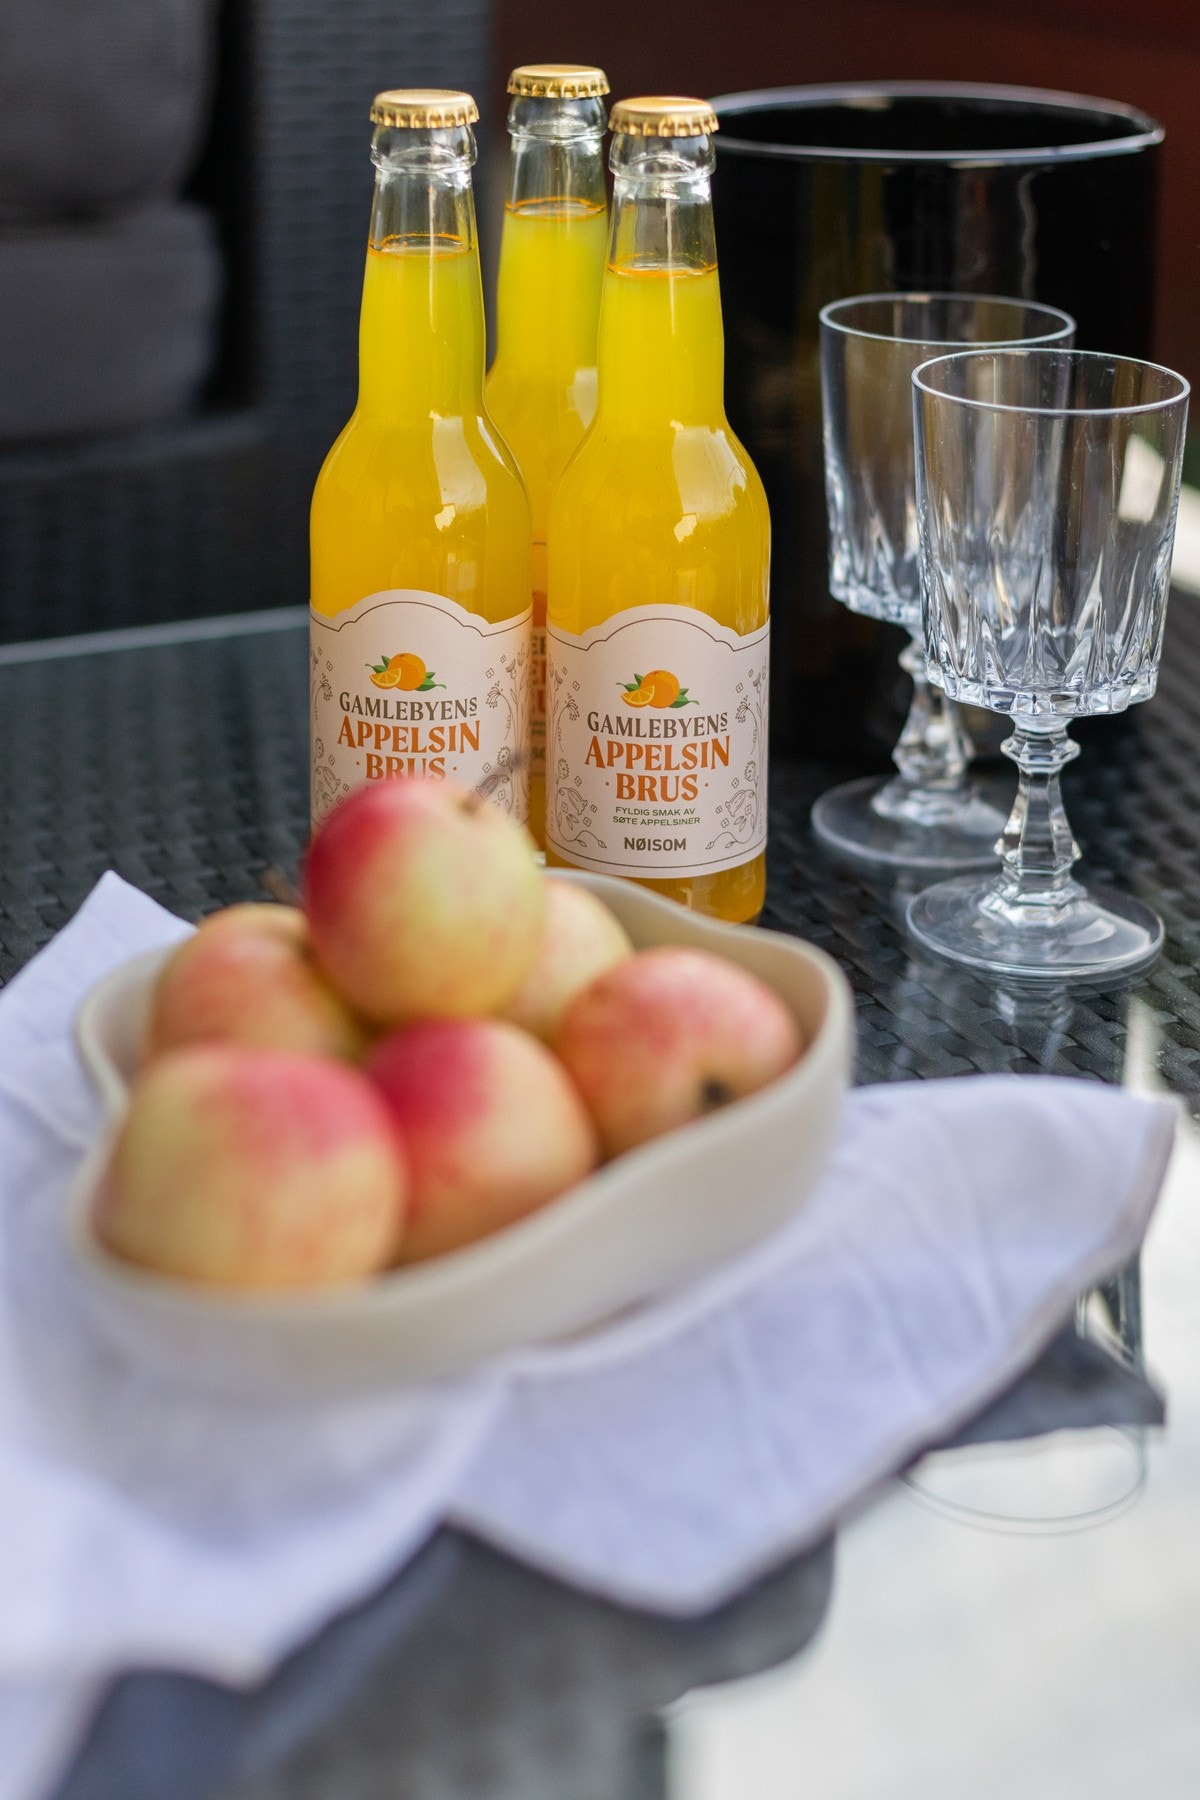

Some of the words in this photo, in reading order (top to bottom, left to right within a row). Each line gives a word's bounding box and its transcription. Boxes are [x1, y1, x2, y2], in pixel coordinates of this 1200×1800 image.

[339, 692, 478, 721] GAMLEBYENS
[337, 715, 481, 754] APPELSIN
[587, 711, 728, 738] GAMLEBYENS
[365, 752, 446, 781] BRUS
[584, 735, 731, 771] APPELSIN
[615, 772, 699, 803] BRUS
[612, 816, 638, 826] SØTE
[640, 817, 701, 827] APPELSINER
[615, 806, 650, 816] FYLDIG
[652, 808, 680, 816] SMAK
[624, 837, 686, 851] NØISOM
